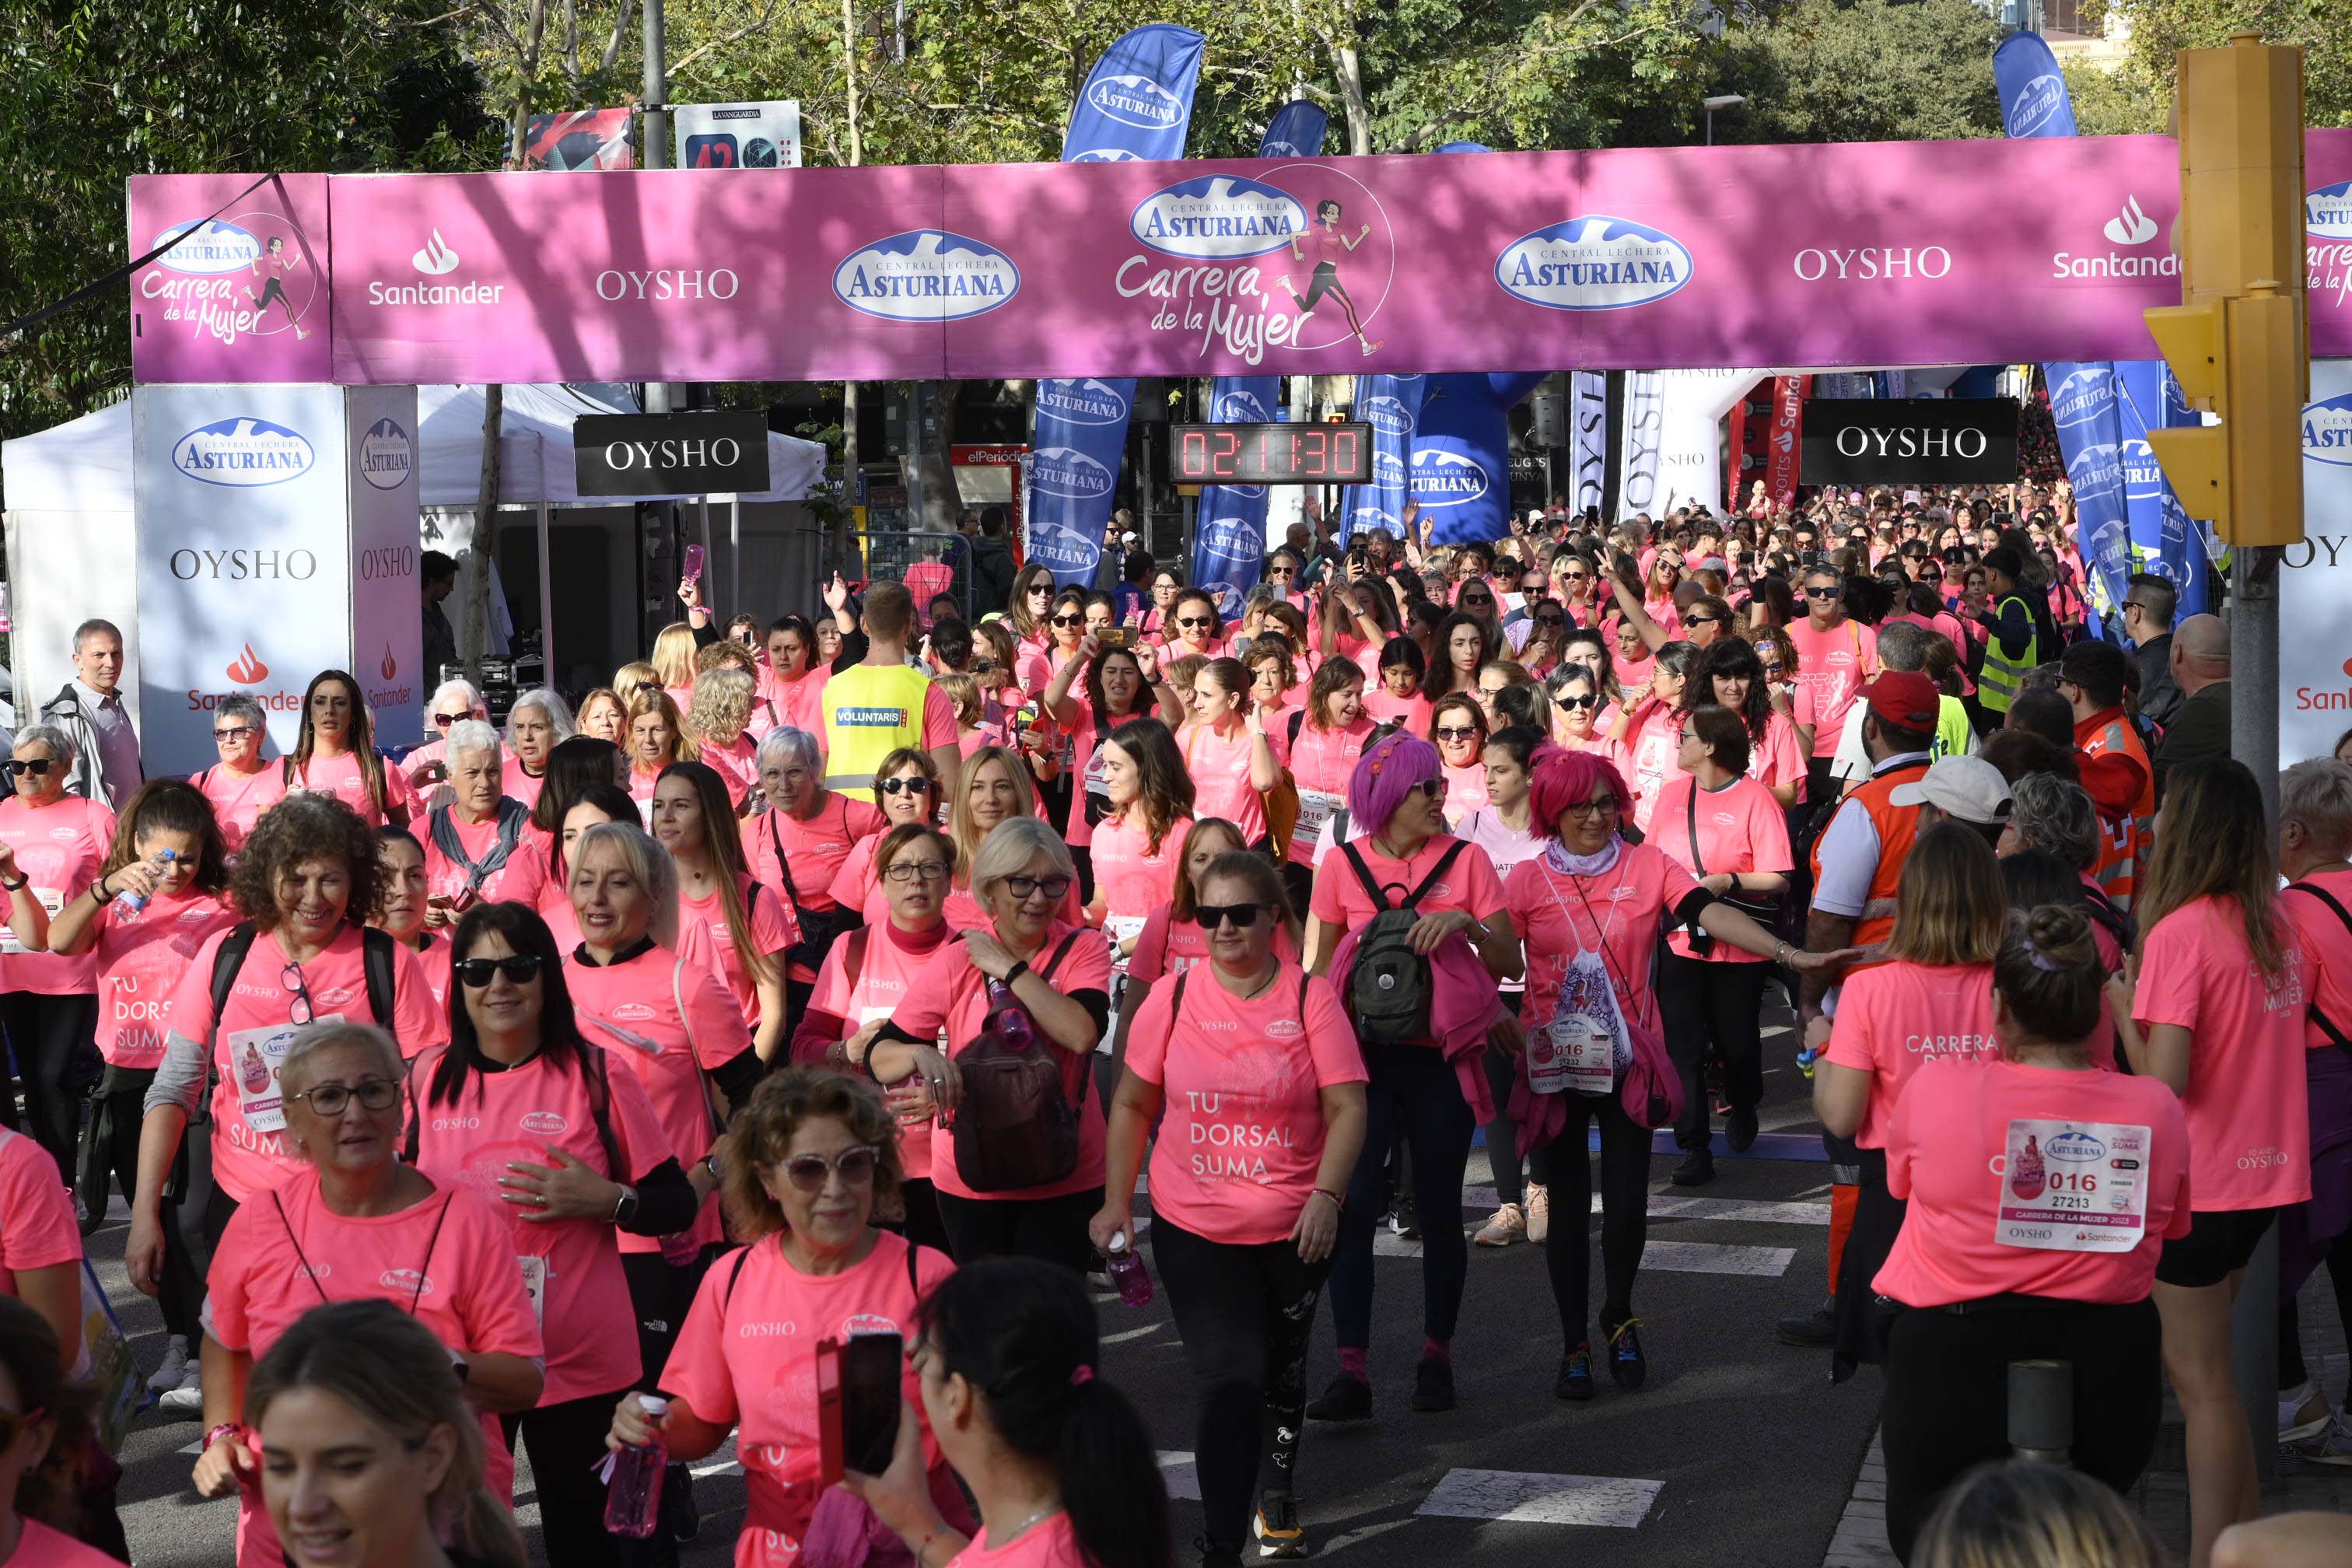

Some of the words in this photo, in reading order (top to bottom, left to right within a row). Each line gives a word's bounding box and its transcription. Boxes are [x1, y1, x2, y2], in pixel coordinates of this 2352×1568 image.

[1094, 83, 1176, 123] ASTURIANA
[1171, 203, 1227, 212] CENTRAL
[1232, 202, 1288, 212] LECHERA
[2307, 204, 2352, 225] ASTU
[1144, 207, 1293, 239] ASTURIANA
[1541, 248, 1601, 258] CENTRAL
[1608, 247, 1671, 257] LECHERA
[2307, 244, 2352, 267] arre
[876, 261, 934, 271] CENTRAL
[940, 261, 999, 270] LECHERA
[1510, 252, 1678, 287] ASTURIANA
[1794, 247, 1951, 281] OYSHO
[142, 270, 232, 299] Carrera
[596, 268, 738, 301] OYSHO
[847, 264, 1006, 298] ASTURIANA
[1116, 255, 1261, 298] Carrera
[2326, 267, 2340, 289] la
[369, 280, 503, 306] Santander
[164, 302, 180, 321] de
[184, 301, 196, 321] la
[194, 296, 267, 345] Mujer
[1151, 301, 1178, 331] de
[1184, 304, 1202, 331] la
[1199, 292, 1315, 366] Mujer
[1036, 385, 1118, 418] ASTURIANA
[1579, 371, 1605, 516] OYSH
[1626, 371, 1661, 509] OYSH
[1836, 426, 1987, 459] OYSHO
[184, 443, 304, 470] ASTURIANA
[364, 444, 408, 472] ASTURIANA
[606, 438, 740, 470] OYSHO
[968, 450, 1020, 464] elPeriódi
[1184, 432, 1356, 475] 02:11:30
[1659, 453, 1704, 467] YSHO
[1034, 467, 1105, 491] STURIANA
[1410, 478, 1481, 492] TURIANA
[1031, 536, 1057, 544] ENTRAL
[1207, 532, 1258, 556] ASTURIANA
[362, 545, 413, 580] OYSHO
[1030, 543, 1092, 565] TURIANA
[2280, 535, 2349, 569] OY
[170, 548, 317, 580] OYSHO
[368, 686, 411, 709] Santander
[837, 712, 899, 722] VOLUNTARIS
[1303, 810, 1322, 821] 016
[1549, 954, 1570, 971] TU
[110, 976, 138, 993] TU
[236, 983, 279, 999] OYSHO
[861, 976, 899, 990] OYSHO
[268, 1044, 291, 1053] ASTU
[1556, 1045, 1583, 1055] 016
[1906, 1034, 1999, 1053] CARRERA
[254, 1100, 284, 1110] CARRERA
[1186, 1091, 1219, 1113] TU
[432, 1117, 480, 1132] OYSHO
[523, 1119, 567, 1131] ASTURIANA
[1190, 1122, 1293, 1148] DORSAL
[230, 1122, 285, 1156] SUM
[2049, 1143, 2101, 1157] ASTURIANA
[1192, 1153, 1269, 1178] SUMA
[2237, 1152, 2288, 1169] OYSHO
[2049, 1172, 2097, 1192] 016
[2052, 1196, 2090, 1209] 27213
[2015, 1211, 2053, 1220] CARRERA
[2054, 1213, 2067, 1221] DE
[2067, 1213, 2078, 1222] LA
[2080, 1214, 2108, 1223] MUJER
[2010, 1227, 2053, 1240] OYSHO
[2087, 1232, 2132, 1243] Santander
[740, 1321, 796, 1339] OYSHO
